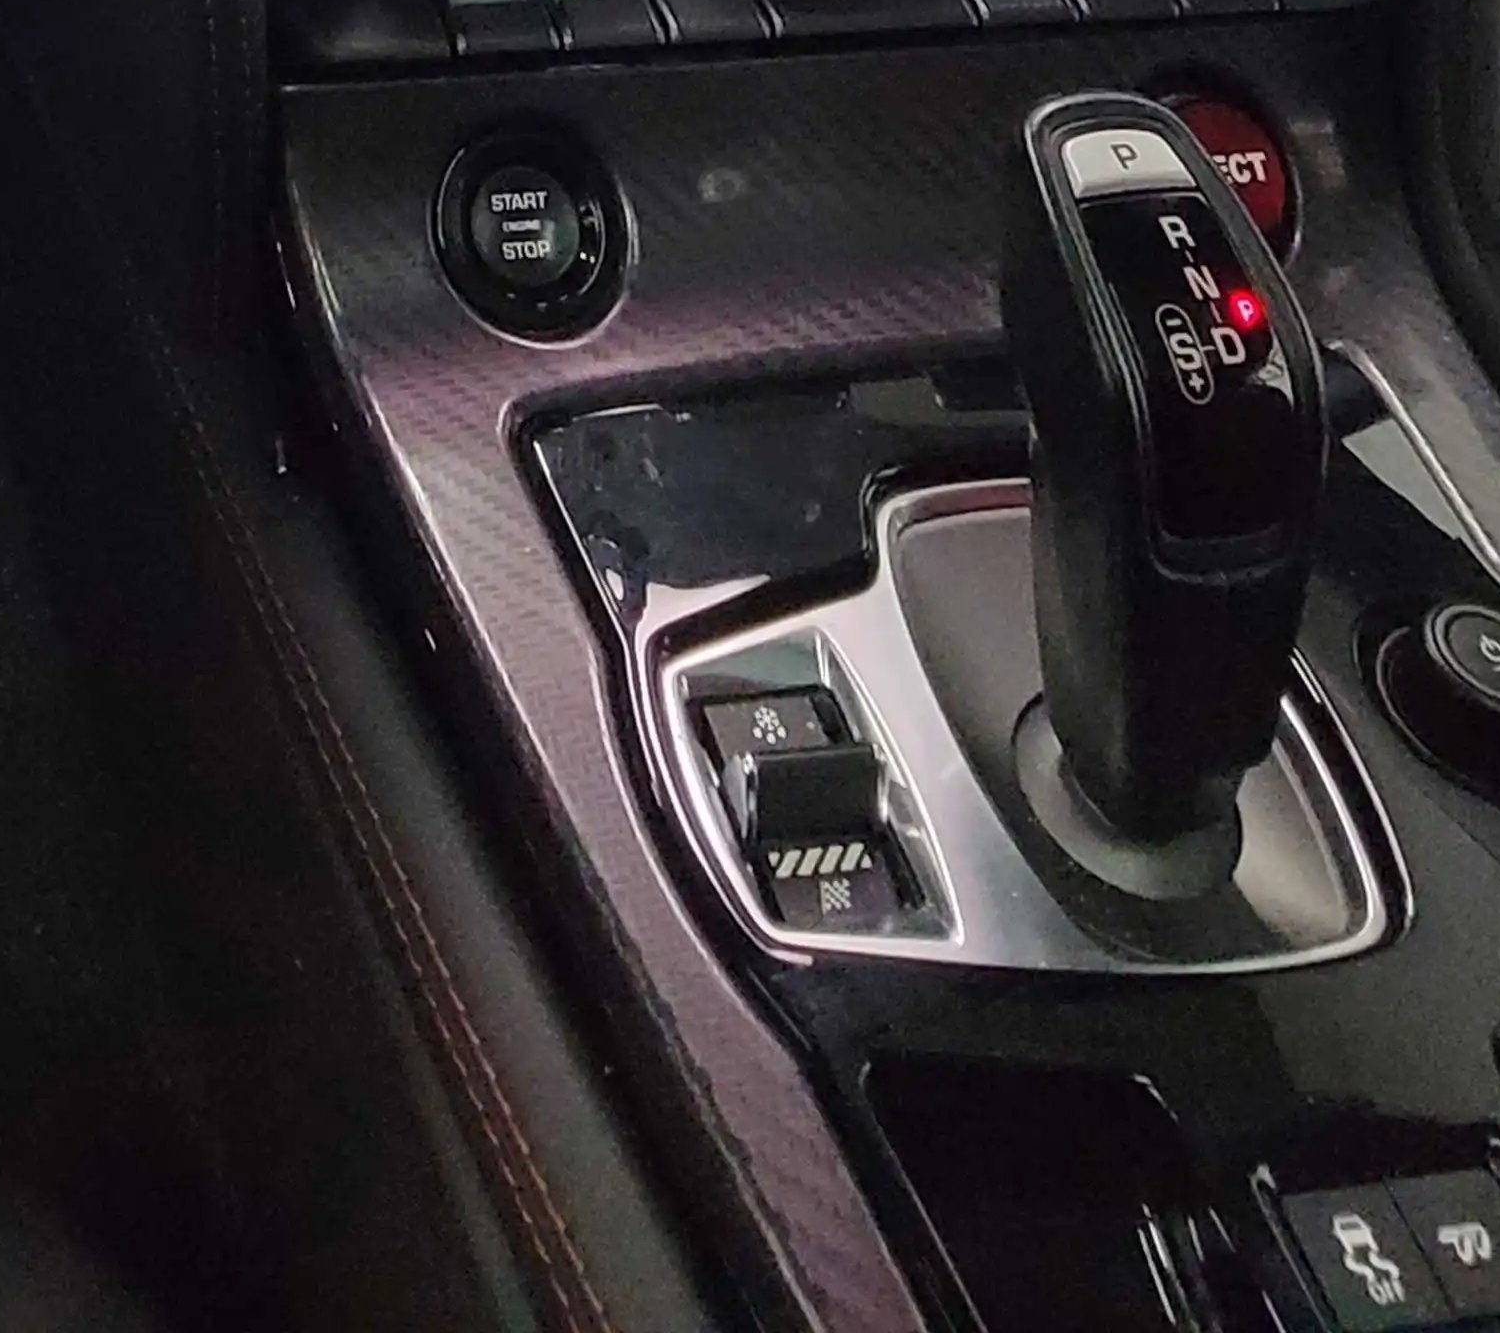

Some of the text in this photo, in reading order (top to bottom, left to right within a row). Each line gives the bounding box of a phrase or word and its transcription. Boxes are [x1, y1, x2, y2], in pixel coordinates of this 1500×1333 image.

[1111, 142, 1139, 170] P
[491, 191, 548, 212] START
[1158, 215, 1196, 249] R
[502, 240, 551, 260] STOP
[1183, 265, 1221, 301] N
[1169, 333, 1202, 371] S
[1210, 327, 1246, 365] D
